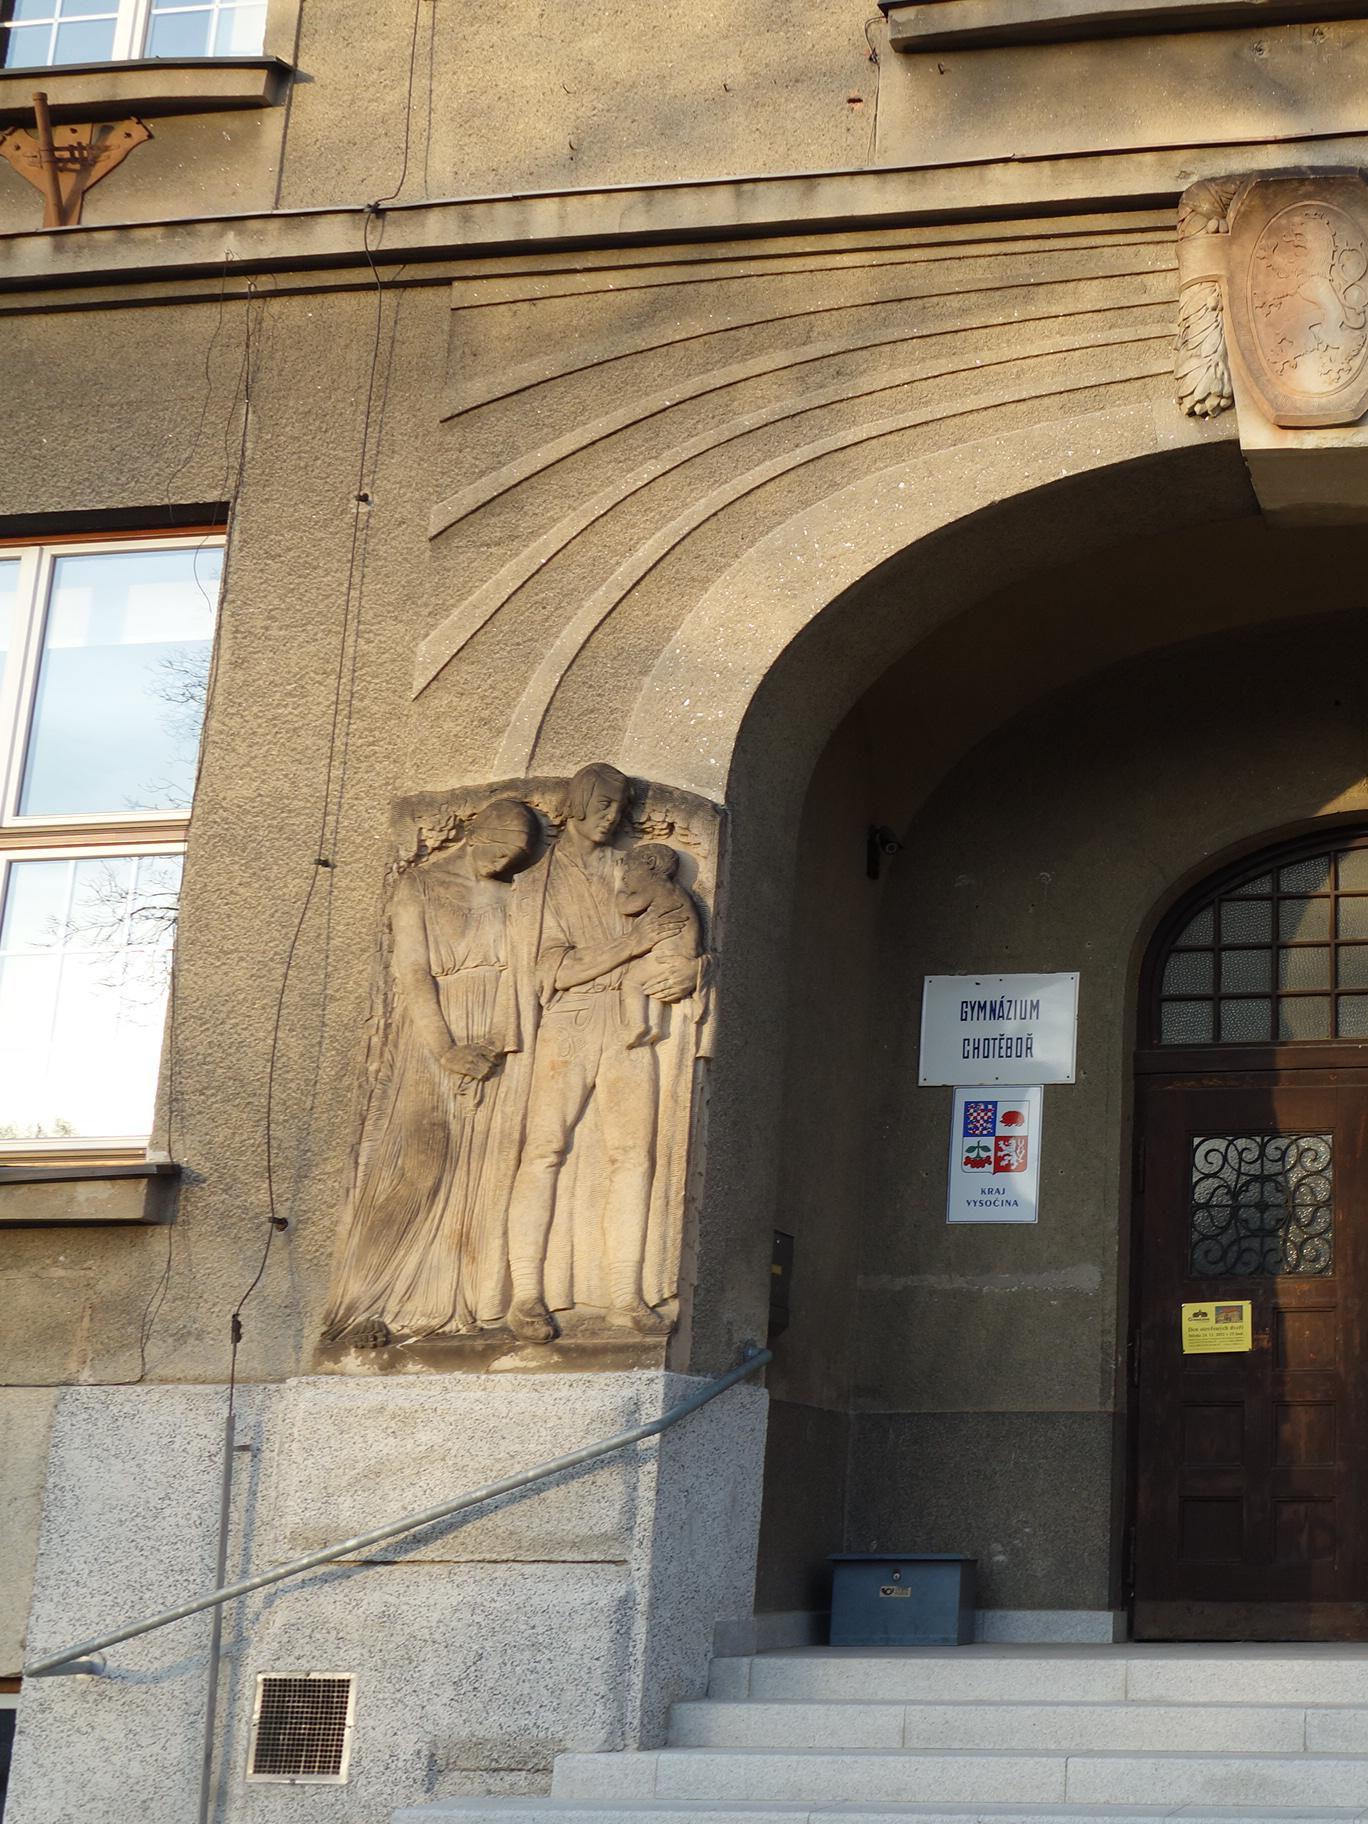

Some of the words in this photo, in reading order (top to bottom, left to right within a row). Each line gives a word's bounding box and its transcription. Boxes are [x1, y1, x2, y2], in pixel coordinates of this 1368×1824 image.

[960, 995, 1040, 1021] GYMNÁZIUM
[962, 1033, 1034, 1059] CHOTĚBOŘ
[980, 1187, 1006, 1195] KRAJ
[966, 1198, 1019, 1207] VYSOČINA
